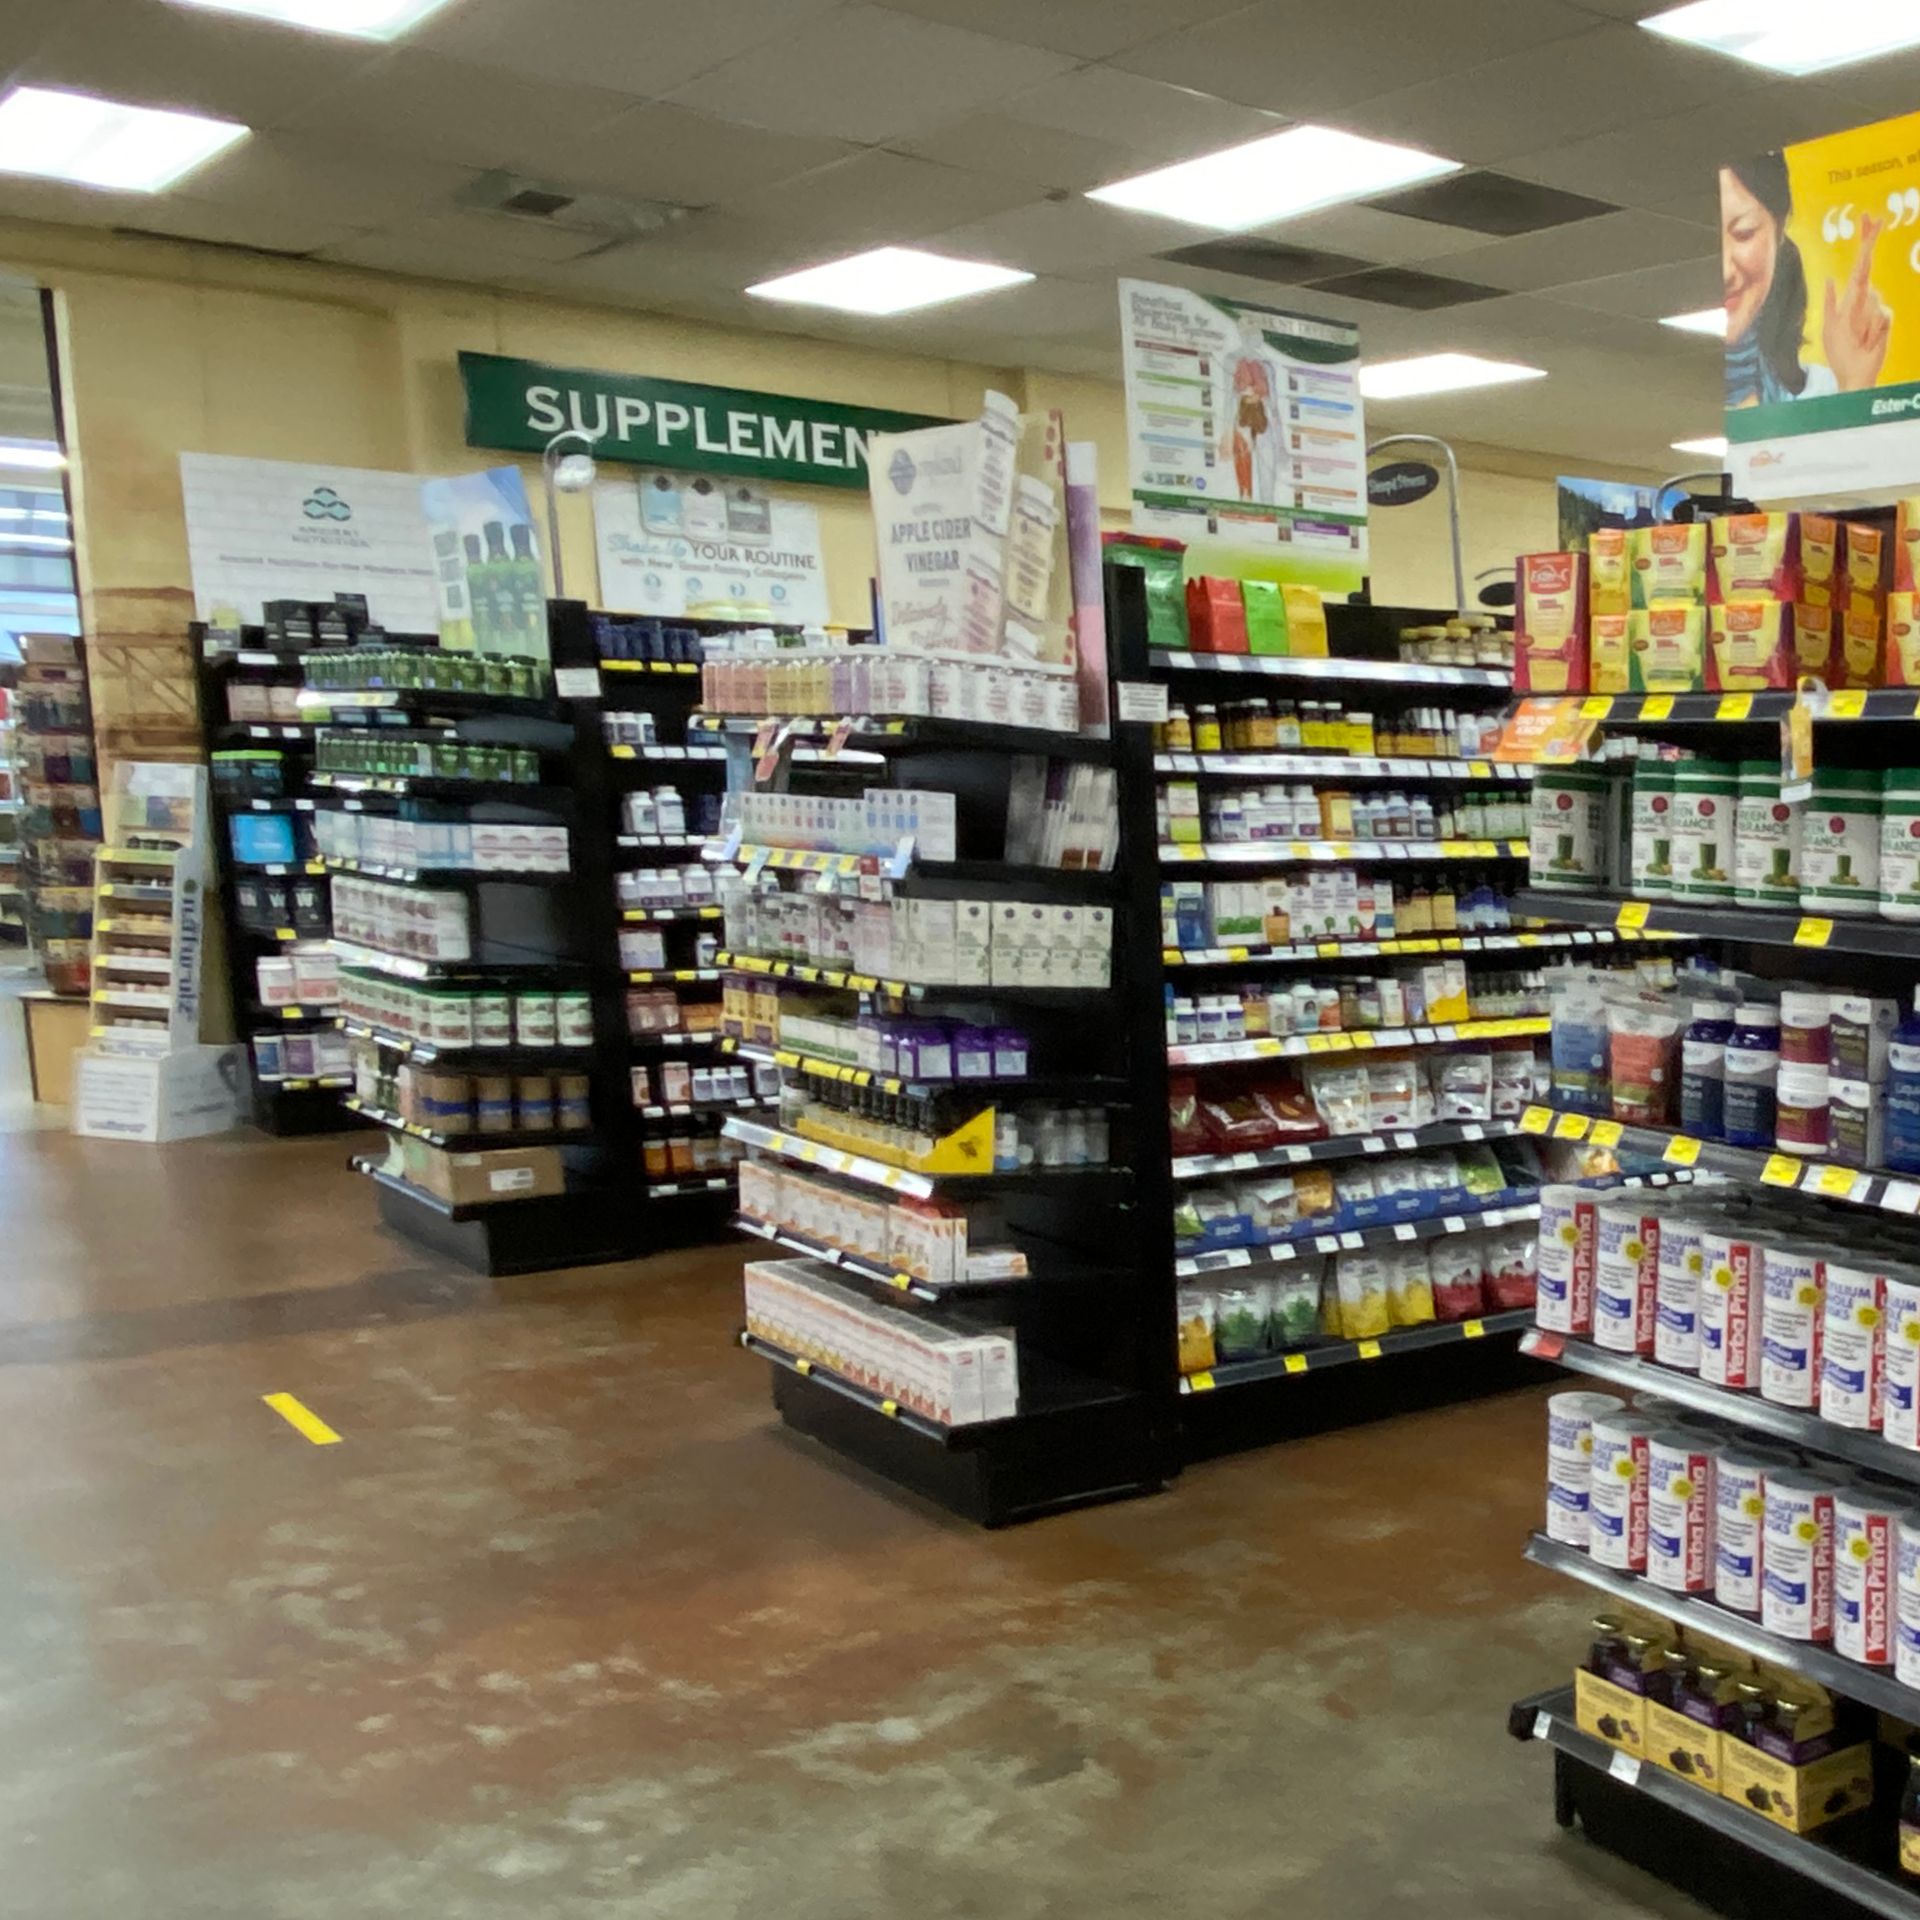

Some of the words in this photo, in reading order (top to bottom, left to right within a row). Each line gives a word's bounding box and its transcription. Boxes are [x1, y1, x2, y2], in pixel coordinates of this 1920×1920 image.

[691, 544, 739, 562] YOUR
[745, 549, 818, 570] ROUTINE
[892, 519, 930, 544] APPLE
[932, 517, 971, 541] CIDER
[905, 550, 960, 572] VINEGAR
[1571, 1270, 1592, 1325] Yerba
[1637, 1287, 1656, 1343] Yerba
[1728, 1318, 1747, 1377] Yerba
[1630, 1508, 1648, 1562] Yerba
[1686, 1525, 1705, 1583] Yerba
[1867, 1526, 1886, 1588] Prima
[1812, 1571, 1830, 1631] Yerba
[1866, 1593, 1885, 1651] Yerba
